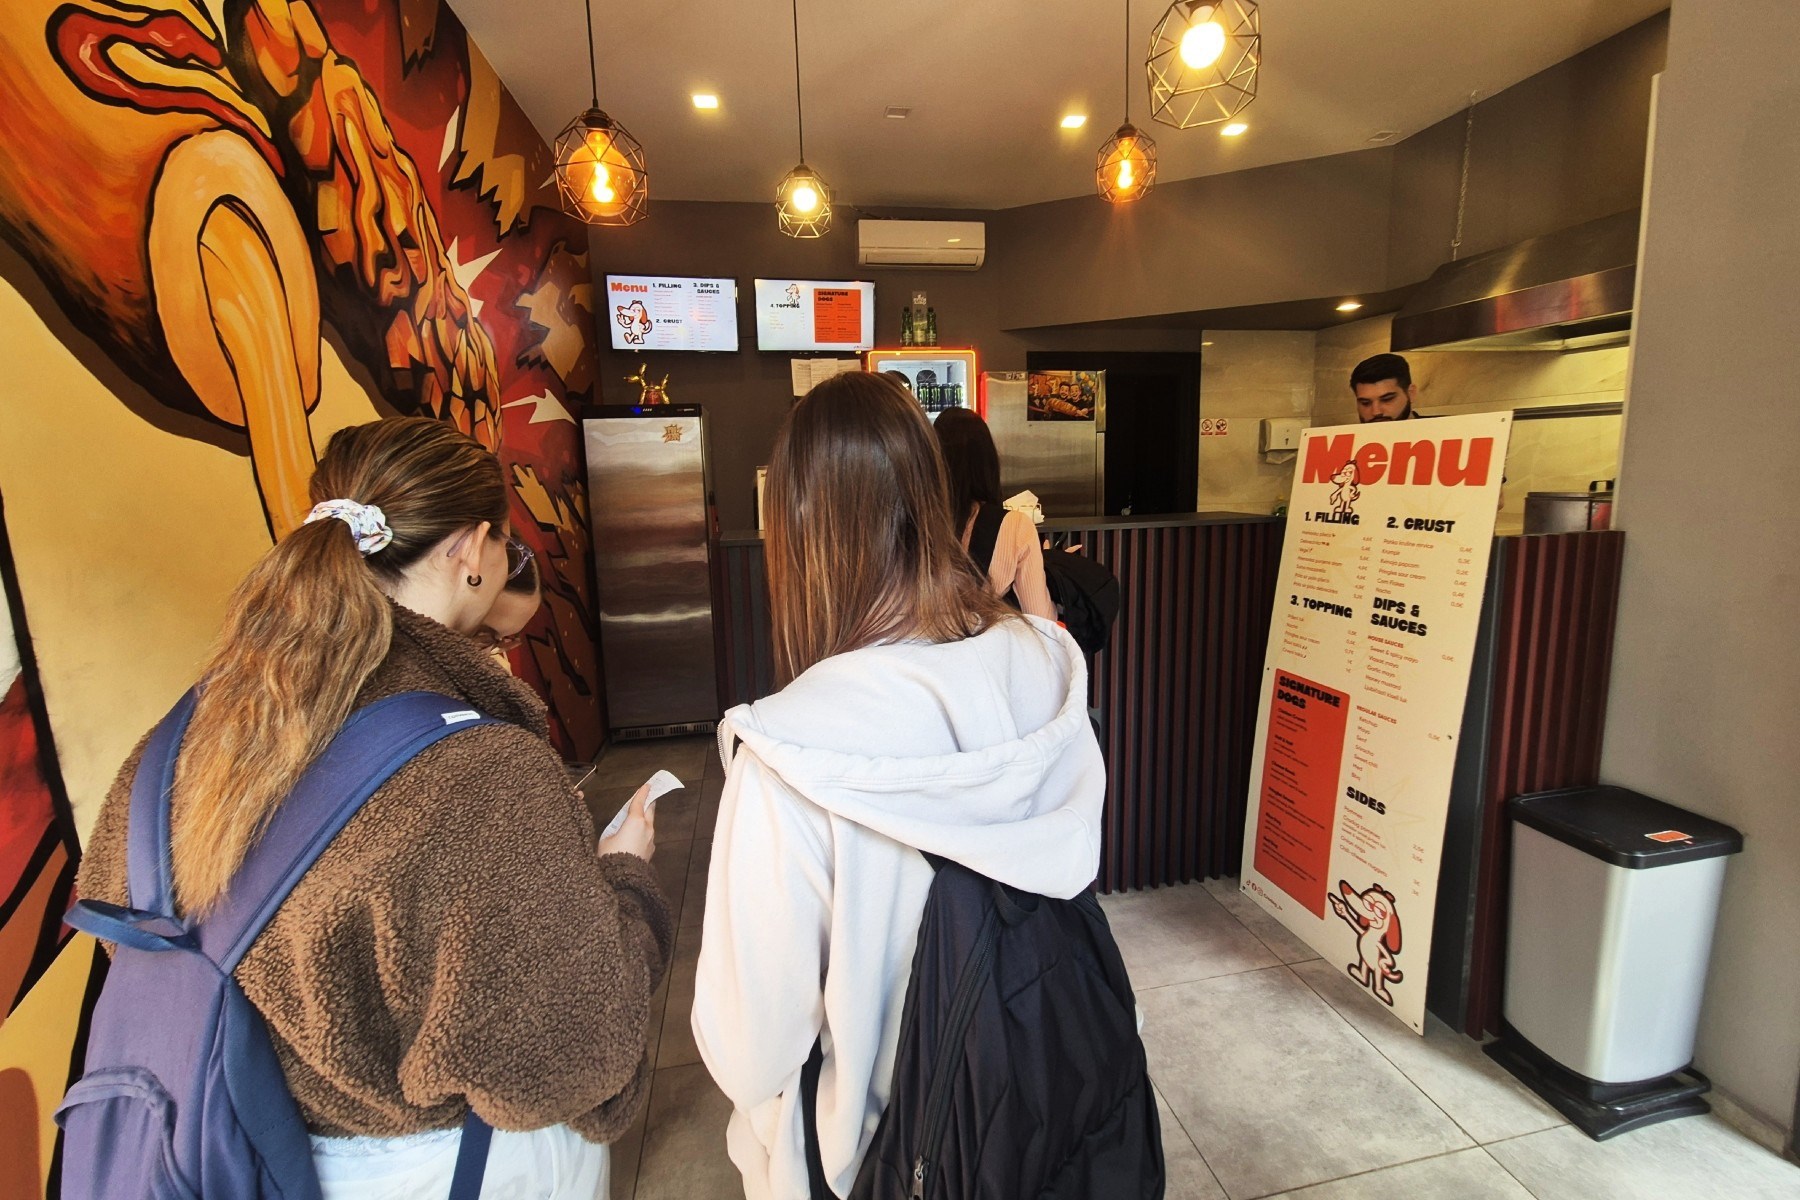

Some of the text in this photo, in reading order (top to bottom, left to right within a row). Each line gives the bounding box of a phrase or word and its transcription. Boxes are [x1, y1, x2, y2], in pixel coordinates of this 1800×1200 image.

[611, 282, 647, 293] Menu
[1301, 433, 1494, 487] Menu
[1305, 511, 1360, 526] 1. FILLING
[1386, 516, 1456, 533] 2. CRUST
[1290, 594, 1352, 618] 3. TOPPING
[1373, 597, 1420, 617] DIPS &
[1370, 613, 1427, 636] SAUCES
[1367, 635, 1403, 647] HOUSE SAUCES
[1277, 688, 1306, 710] DOGS
[1279, 675, 1341, 708] SIGNATURE
[1377, 713, 1397, 724] SAUCES
[1346, 786, 1386, 815] SIDES
